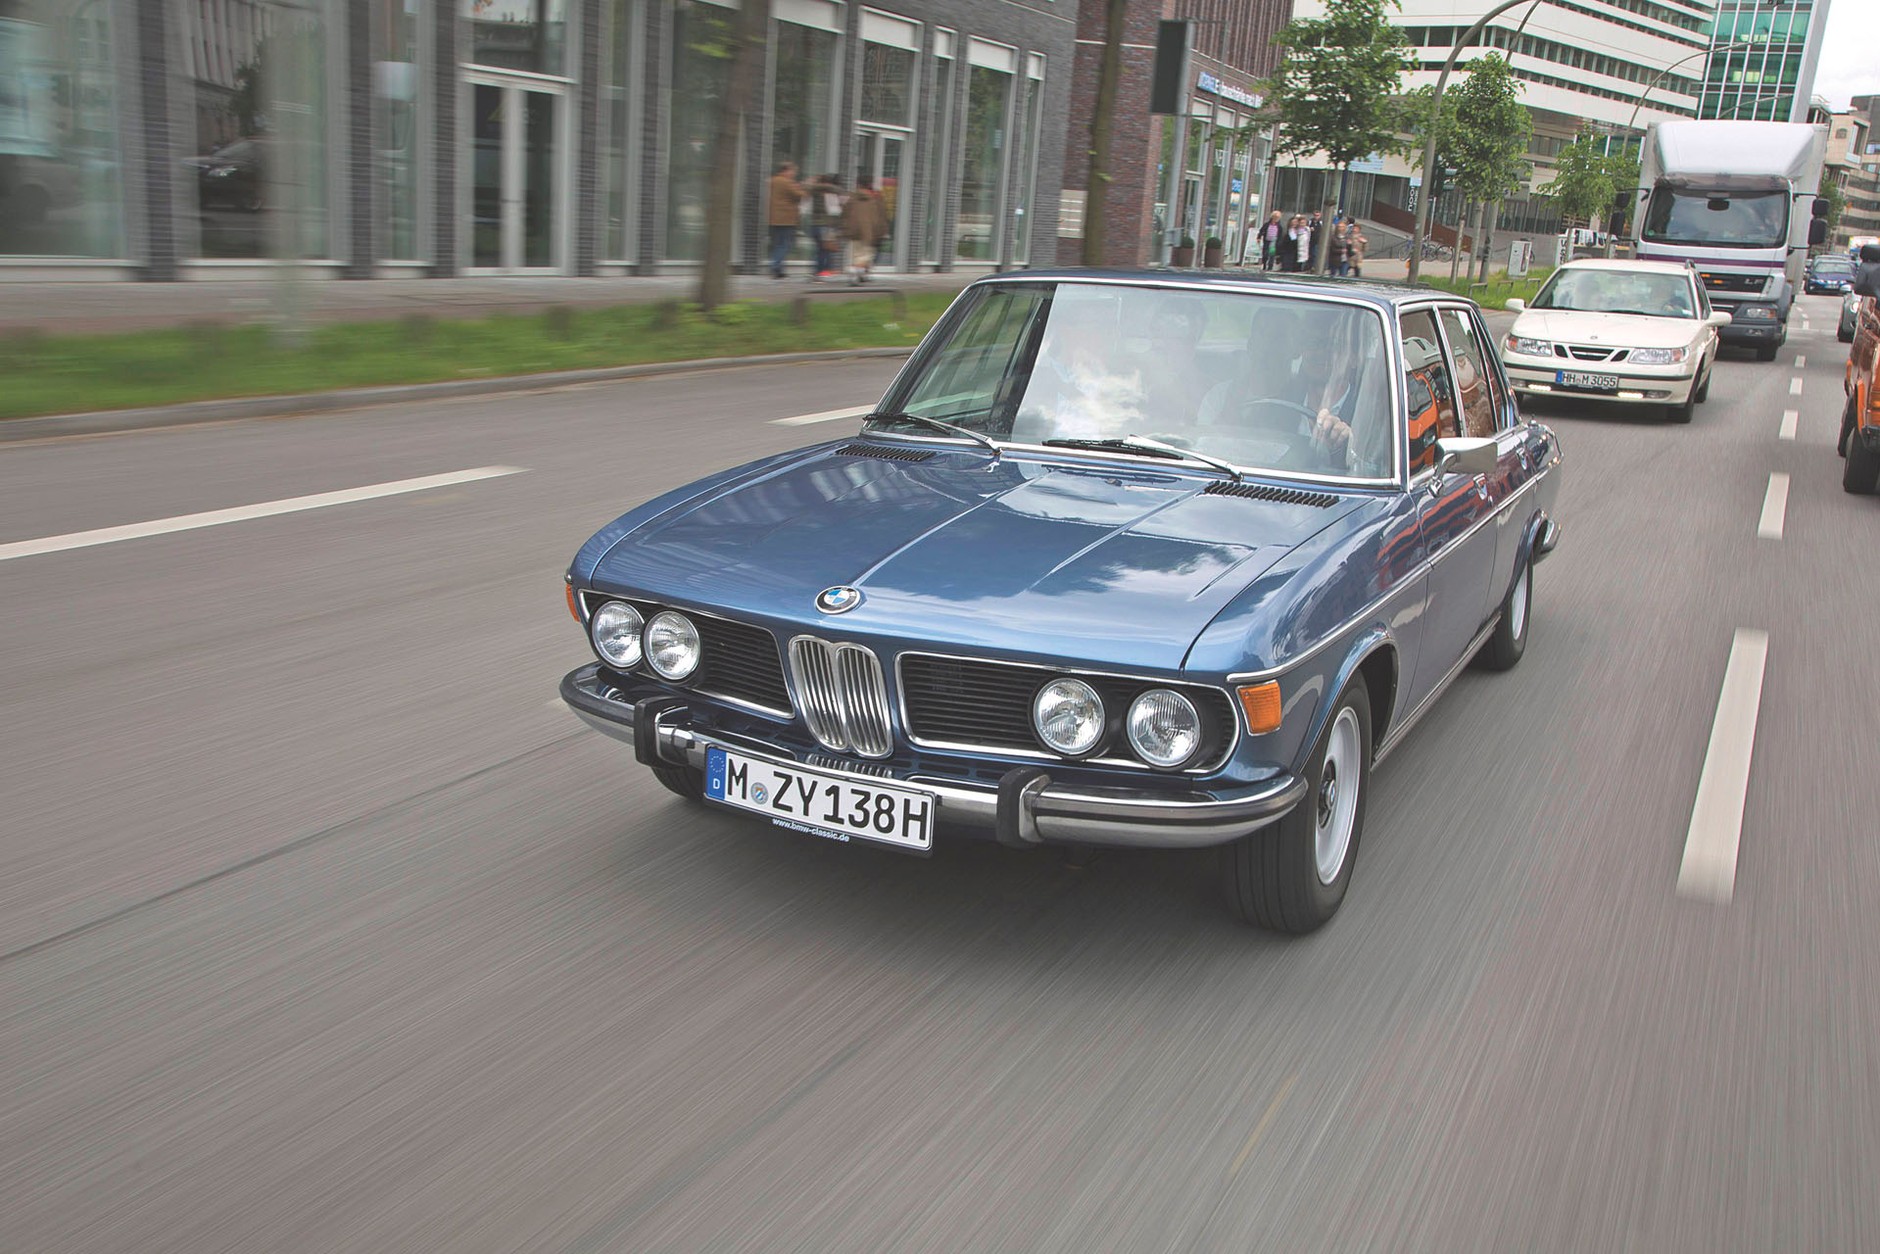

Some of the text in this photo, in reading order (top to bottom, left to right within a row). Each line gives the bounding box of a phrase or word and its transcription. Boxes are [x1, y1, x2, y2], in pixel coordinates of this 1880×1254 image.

[1563, 373, 1576, 383] HH
[712, 777, 721, 790] D
[727, 758, 748, 800] M
[771, 818, 850, 842] www.bmw-classic.de
